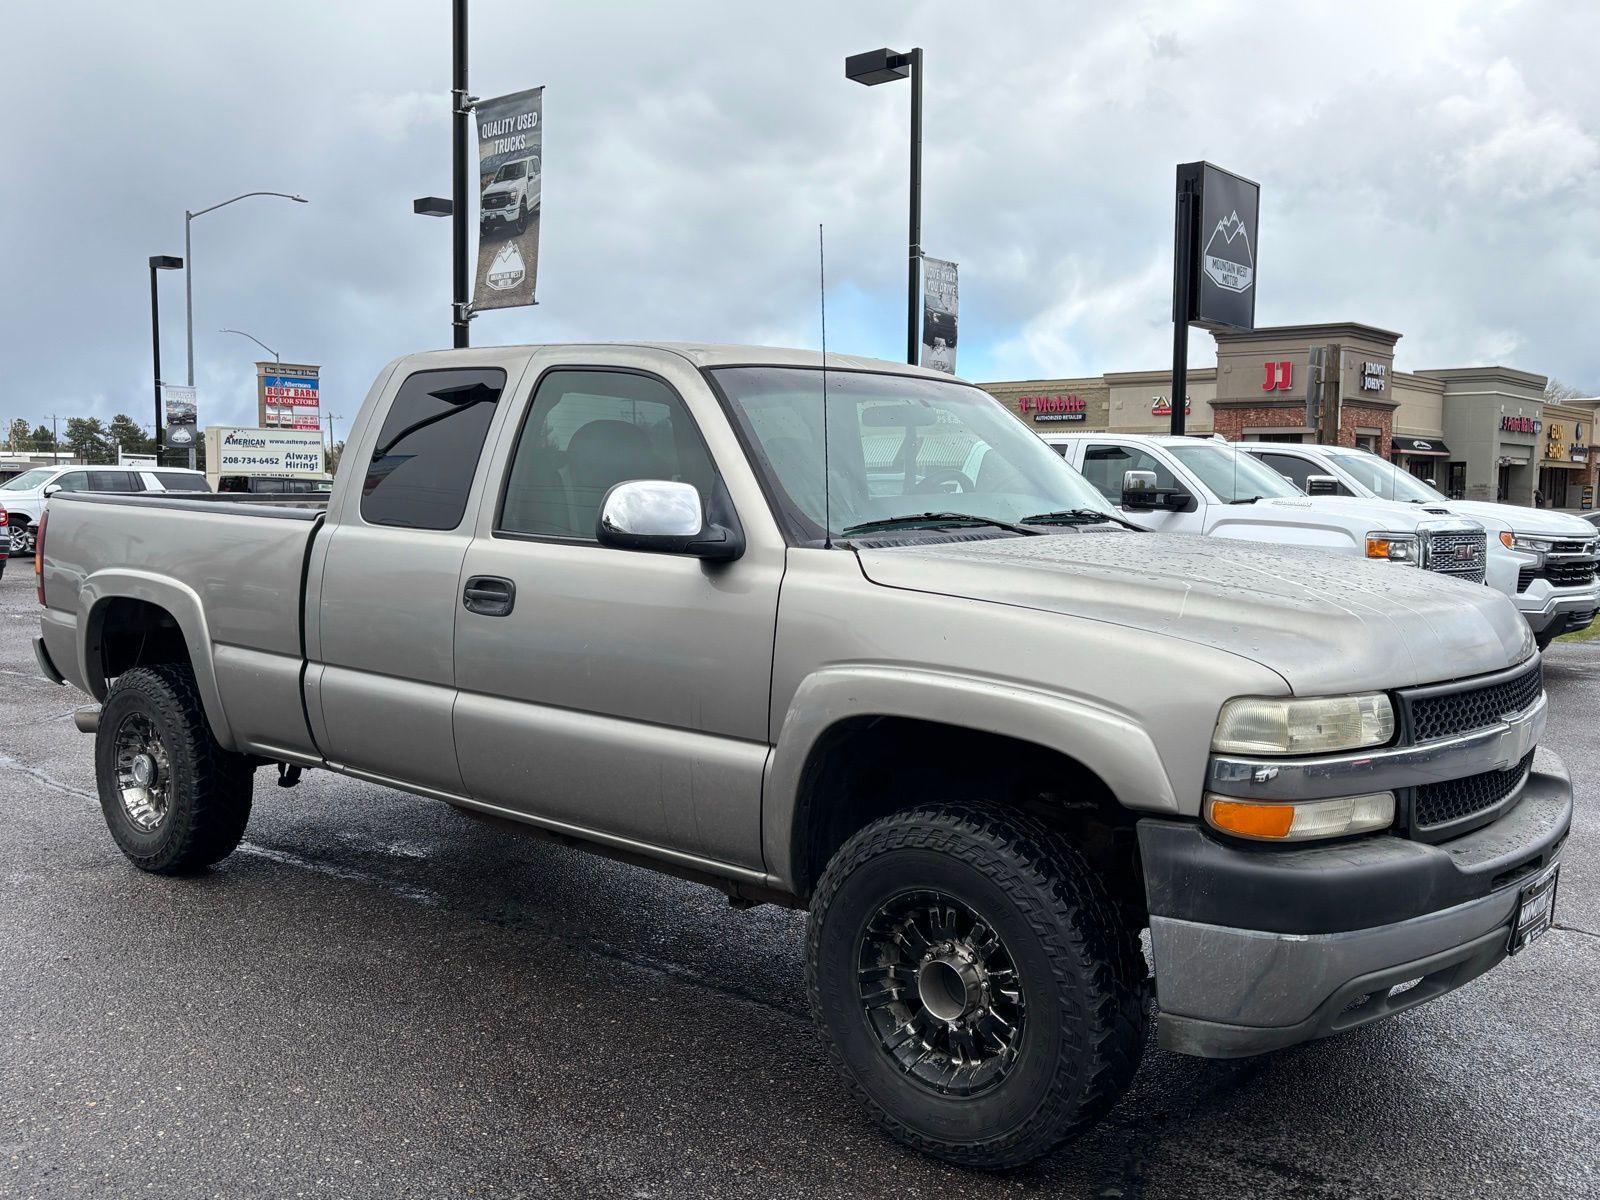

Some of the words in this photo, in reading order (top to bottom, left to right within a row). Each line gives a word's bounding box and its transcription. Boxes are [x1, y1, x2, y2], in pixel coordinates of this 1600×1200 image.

[482, 117, 515, 139] QUALITY
[517, 112, 538, 131] USED
[494, 134, 526, 155] TRUCKS
[1212, 259, 1236, 274] MOUNTAIN
[927, 279, 939, 292] YOU
[940, 282, 957, 296] DRIVE
[1222, 273, 1239, 287] MOTOR
[1364, 361, 1386, 376] JIMMY
[1363, 376, 1385, 391] JOHN'S
[267, 387, 290, 396] BOOT
[294, 388, 317, 397] BARN
[1551, 423, 1564, 439] GUN
[224, 437, 266, 446] AMERICAN
[285, 452, 318, 462] Always
[1548, 442, 1564, 458] SHOP
[222, 456, 279, 465] 208-734-6452
[285, 462, 318, 471] Hiring!
